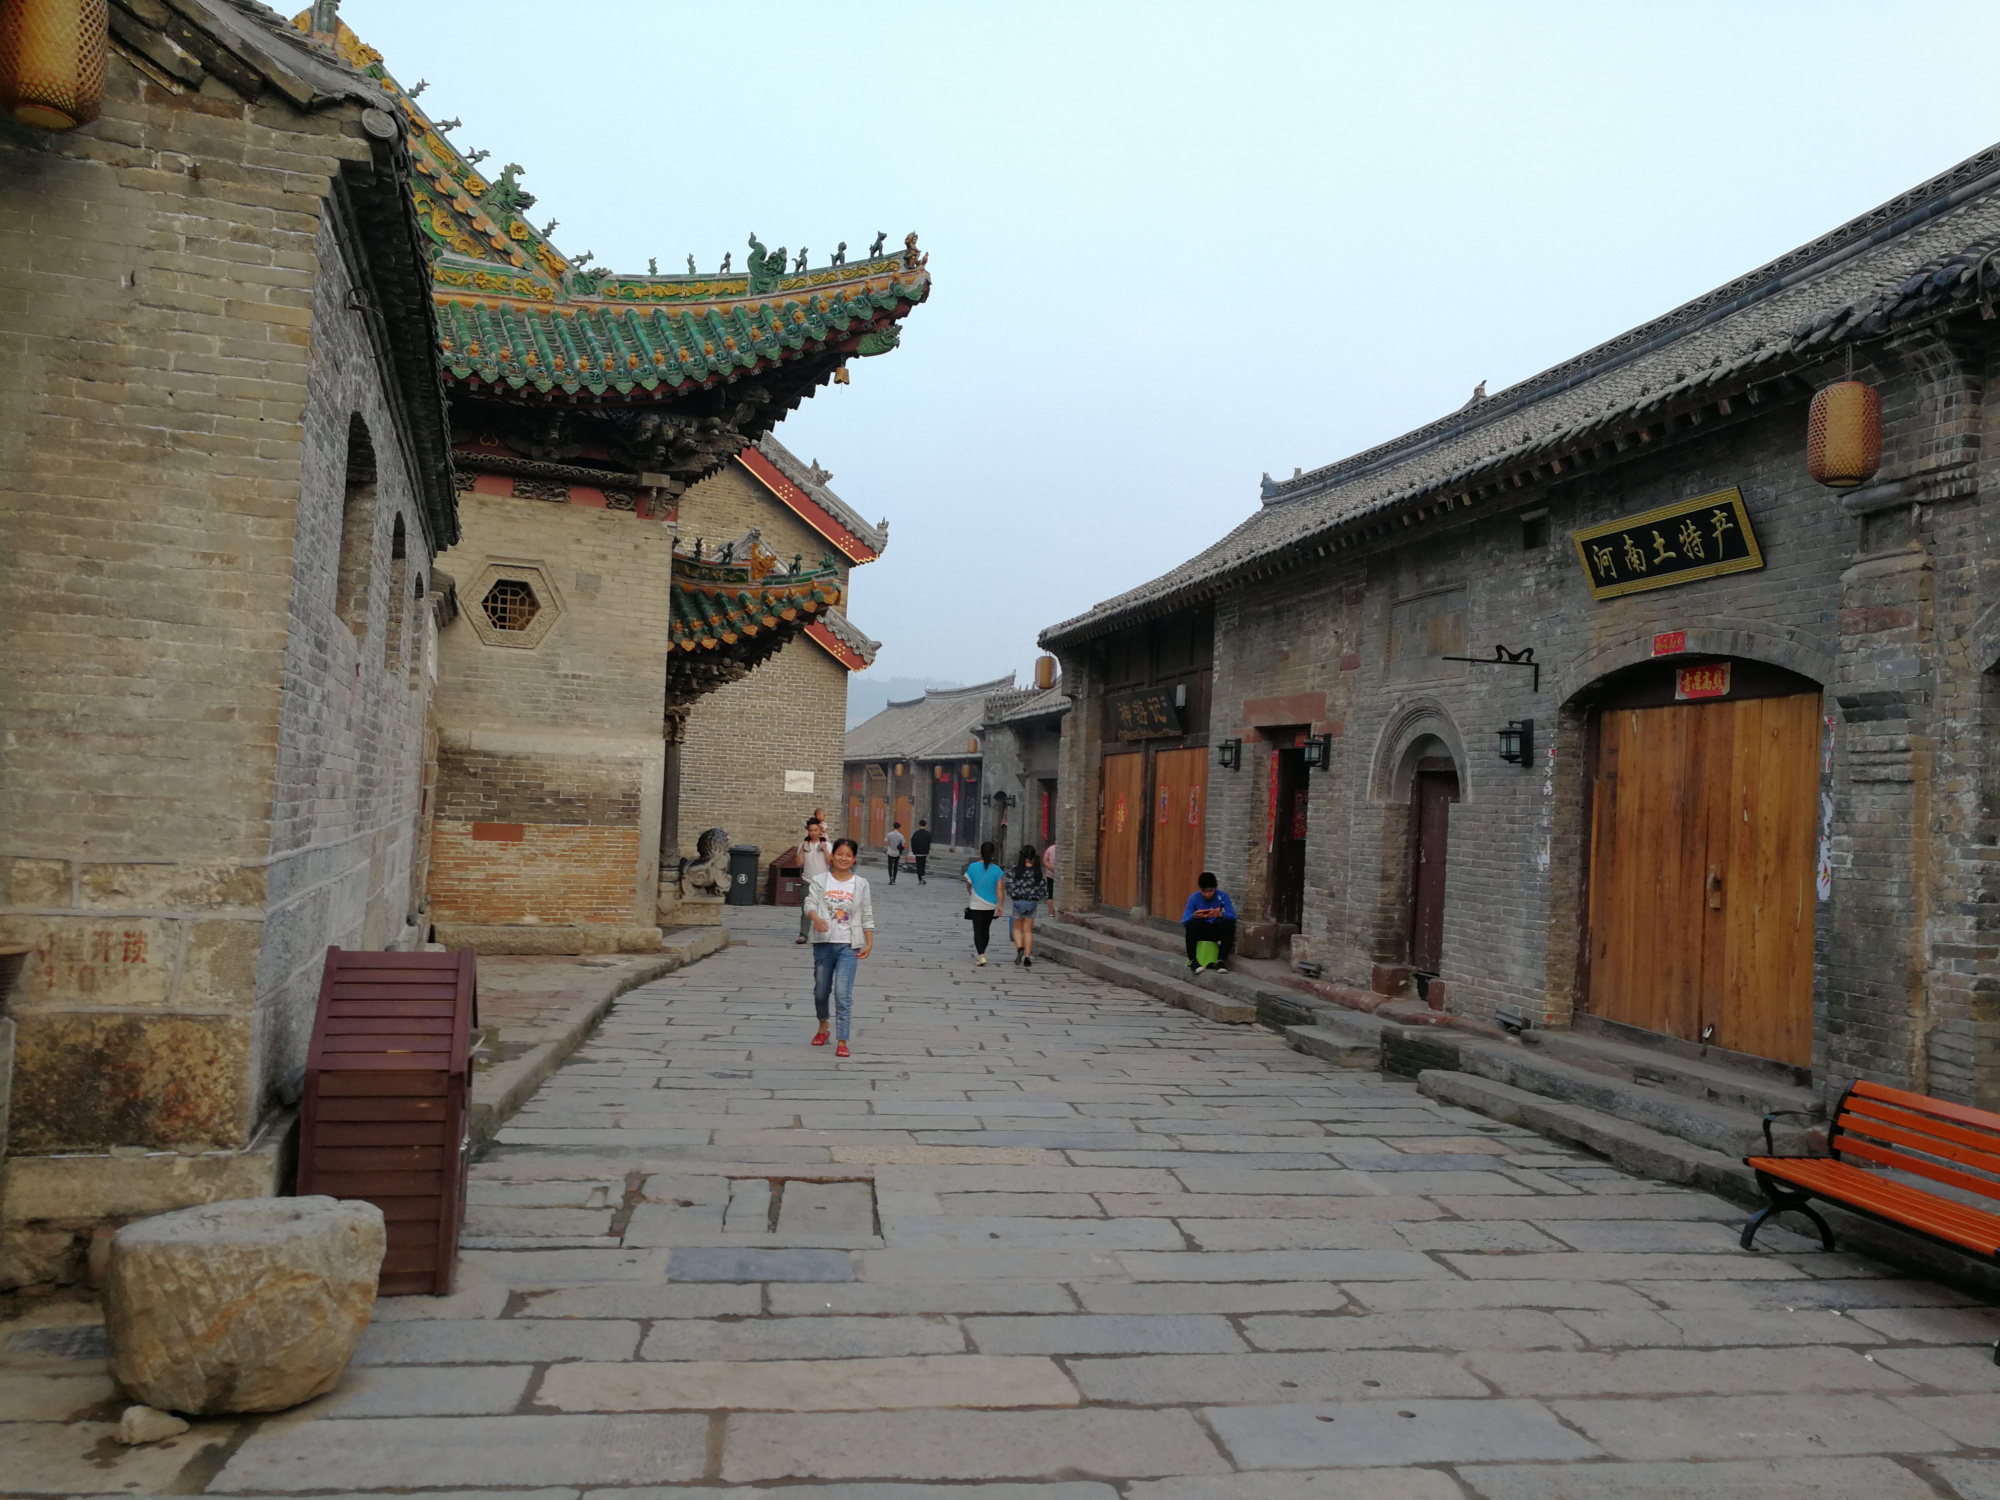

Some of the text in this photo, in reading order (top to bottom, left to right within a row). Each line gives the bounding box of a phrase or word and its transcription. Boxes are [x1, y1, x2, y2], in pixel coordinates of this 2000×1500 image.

[1593, 509, 1734, 579] 河南土特产
[1682, 670, 1724, 692] 吉星高照
